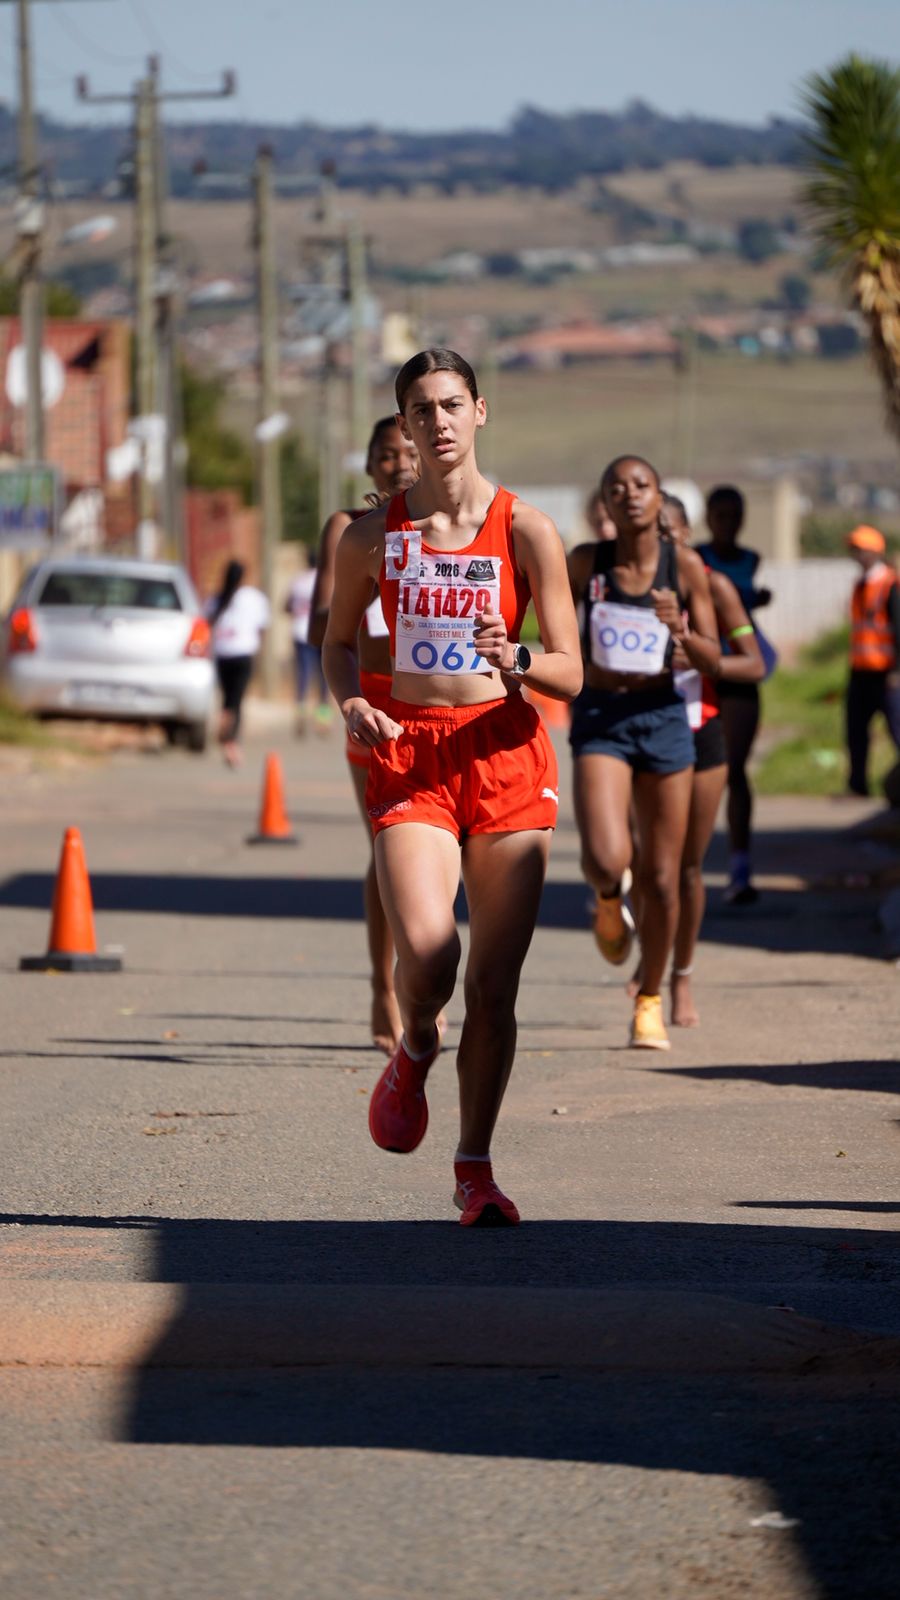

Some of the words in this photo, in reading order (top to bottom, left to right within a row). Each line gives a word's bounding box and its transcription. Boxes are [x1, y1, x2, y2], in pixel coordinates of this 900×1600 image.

[393, 539, 409, 571] J
[470, 562, 492, 572] ASA
[434, 563, 460, 577] 2026
[599, 626, 659, 653] 002
[411, 640, 482, 671] 067
